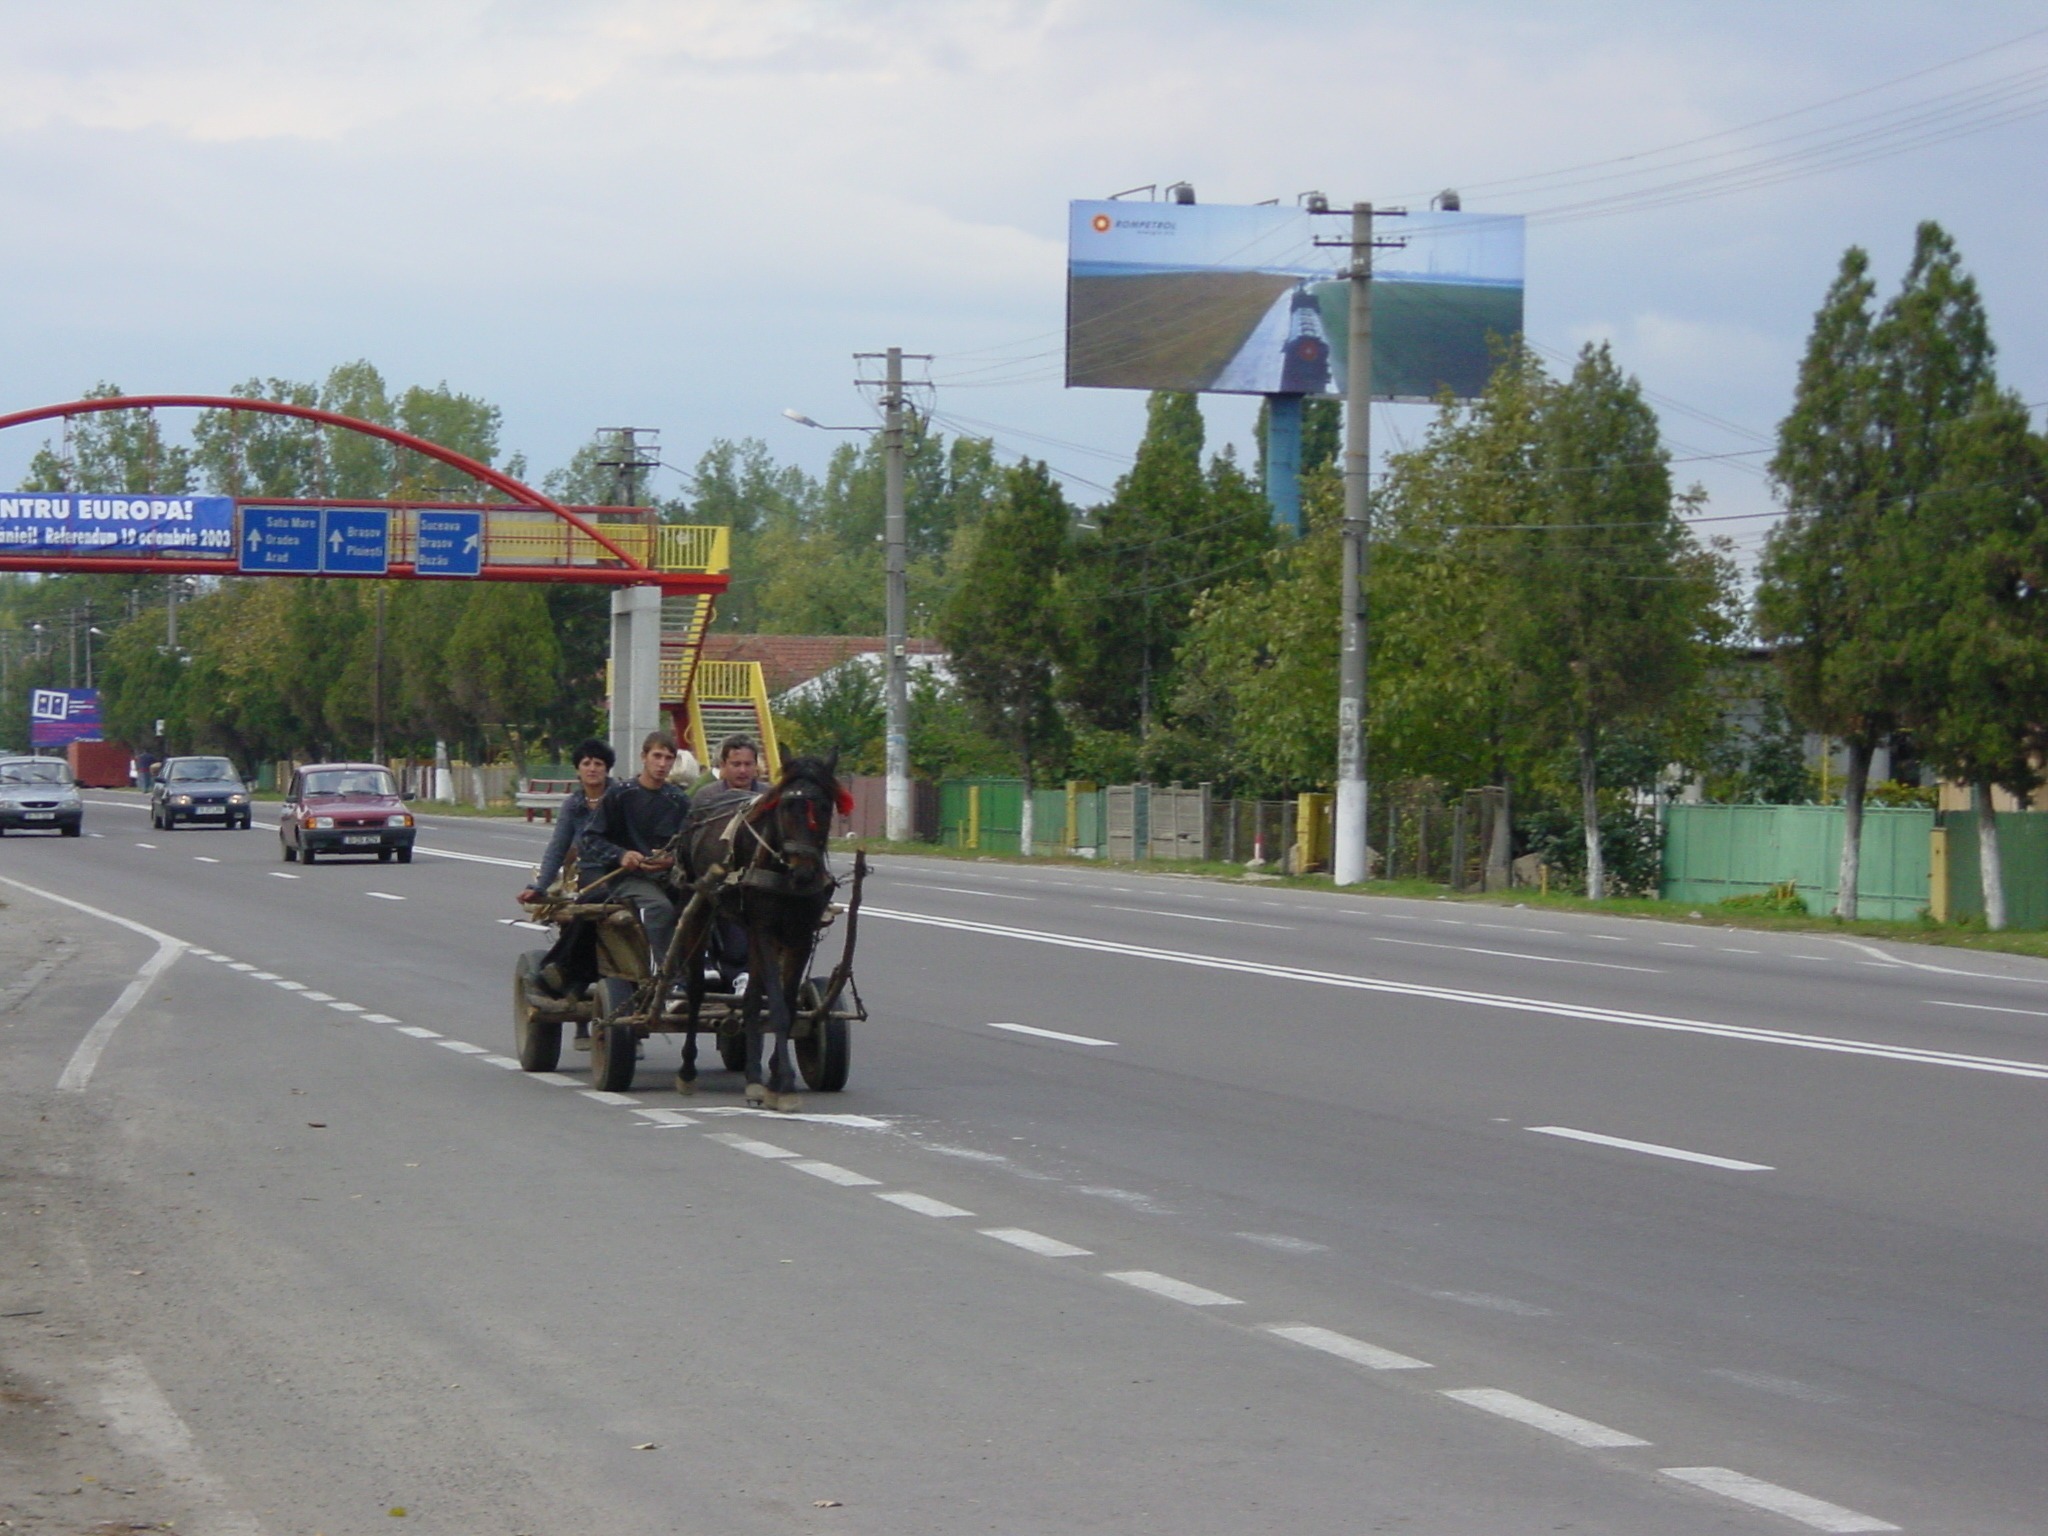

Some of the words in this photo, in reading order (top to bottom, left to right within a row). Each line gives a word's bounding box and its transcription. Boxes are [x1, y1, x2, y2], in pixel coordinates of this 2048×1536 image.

[1115, 219, 1177, 230] ROMPETROL
[78, 499, 193, 521] EUROPA!
[266, 516, 290, 528] Satu
[291, 517, 317, 529] Mare
[421, 519, 461, 531] Suceava
[121, 527, 137, 545] 19
[200, 528, 231, 547] 2003
[265, 534, 300, 545] Oradea
[265, 551, 289, 563] Arad
